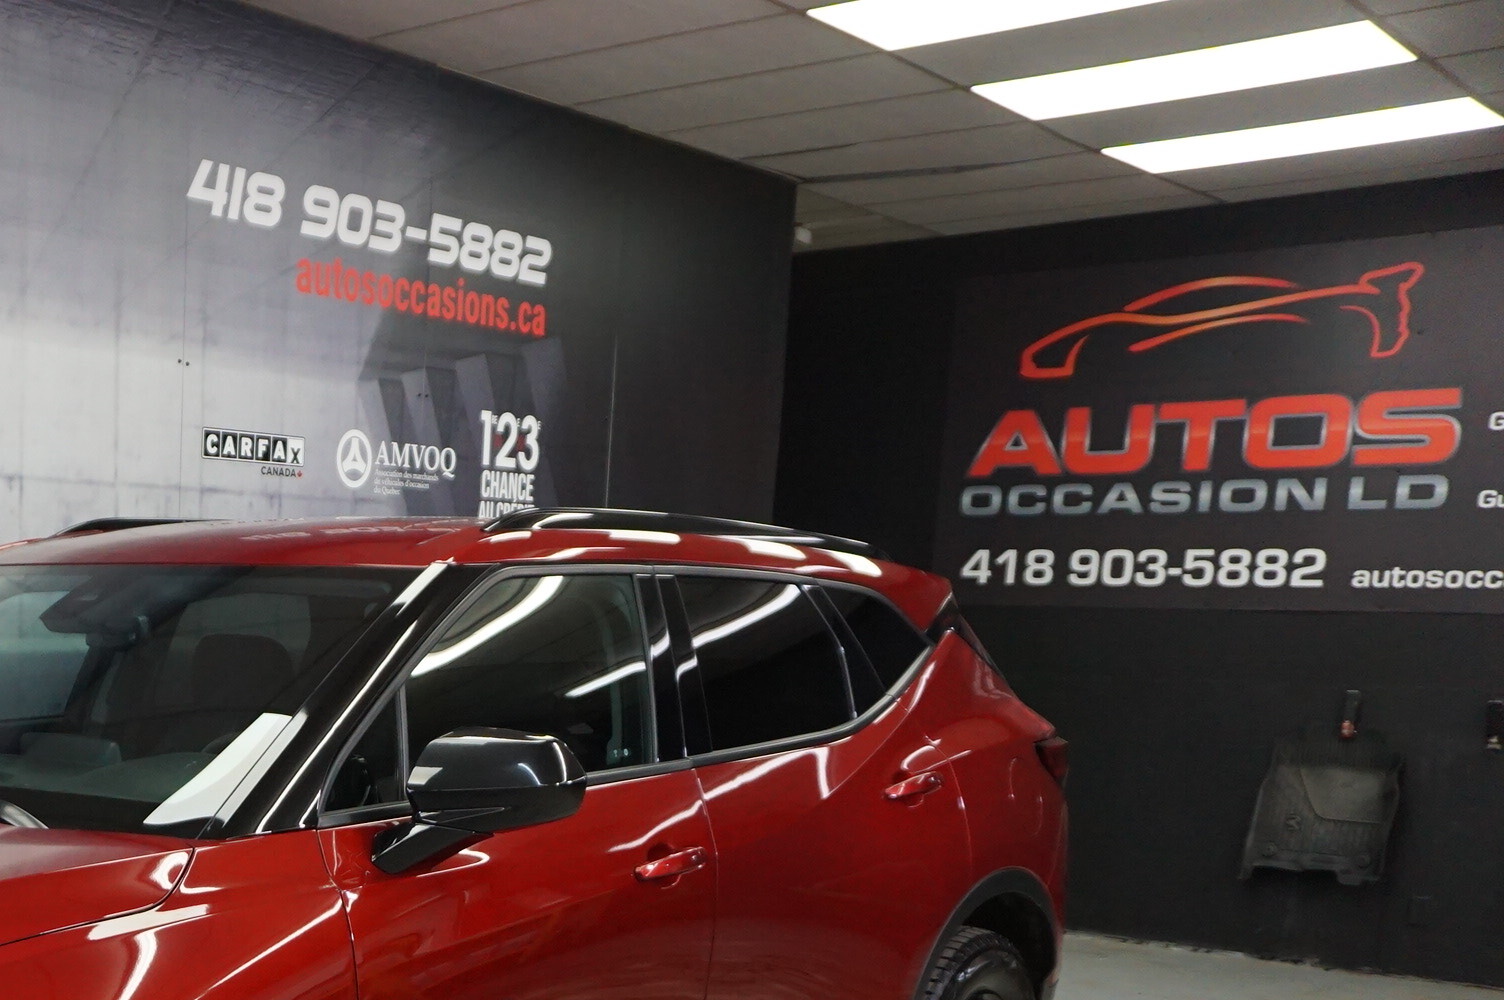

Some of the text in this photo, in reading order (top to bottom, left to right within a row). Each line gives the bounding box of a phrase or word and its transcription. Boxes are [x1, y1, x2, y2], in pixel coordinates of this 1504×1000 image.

[186, 158, 553, 286] 418 903-5882
[295, 256, 548, 337] autosoccasions.ca
[205, 431, 302, 465] CARFAX
[966, 387, 1463, 478] AUTOS
[260, 466, 297, 478] CANADA
[374, 440, 457, 478] AMVOQ
[480, 469, 535, 502] CHANCE
[959, 474, 1450, 517] OCCASION LD
[959, 547, 1328, 588] 418 903-5882
[1350, 565, 1504, 590] autosocc
